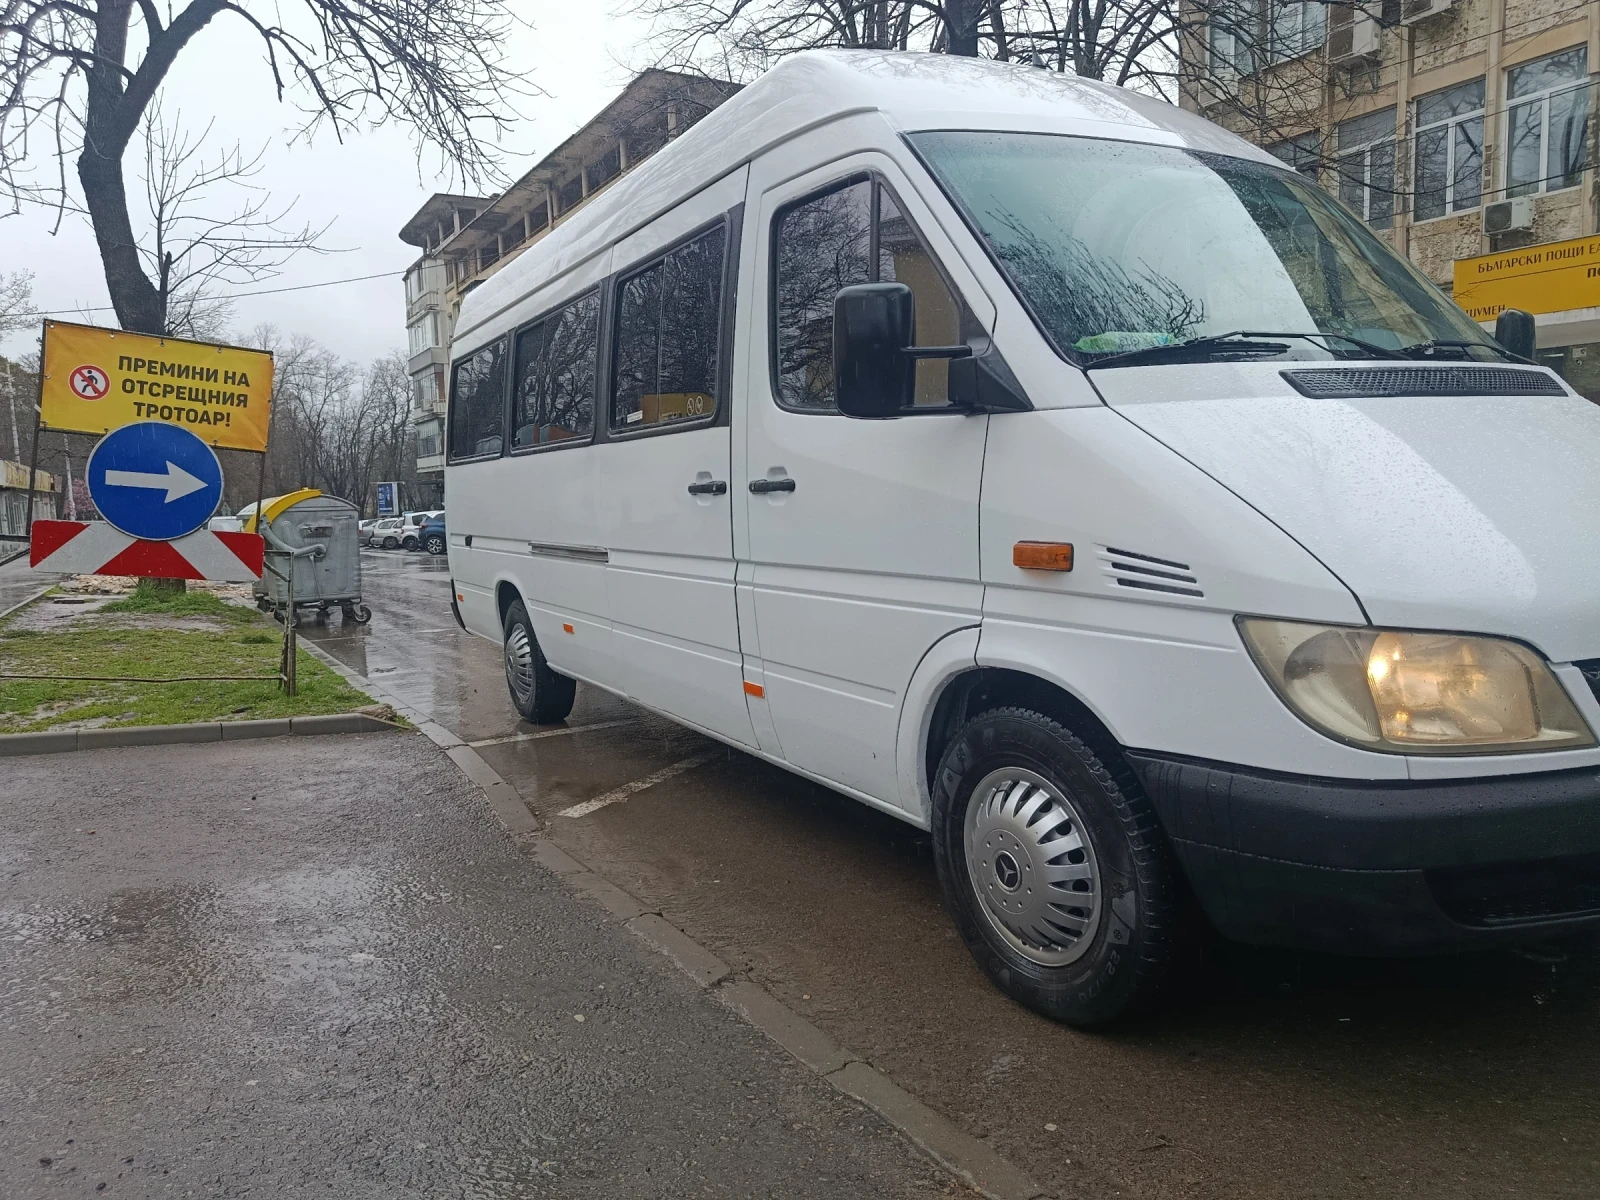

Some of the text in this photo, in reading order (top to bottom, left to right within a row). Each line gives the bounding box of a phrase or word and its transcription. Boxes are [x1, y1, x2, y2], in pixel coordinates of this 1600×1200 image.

[1478, 253, 1542, 273] БЪЛГАРСКИ
[1546, 245, 1584, 262] ПОЩИ
[118, 355, 250, 387] ПРЕМИНИ НА
[121, 378, 248, 408] ОТСРЕЩНИЯ
[133, 401, 231, 427] ТРОТОАР!
